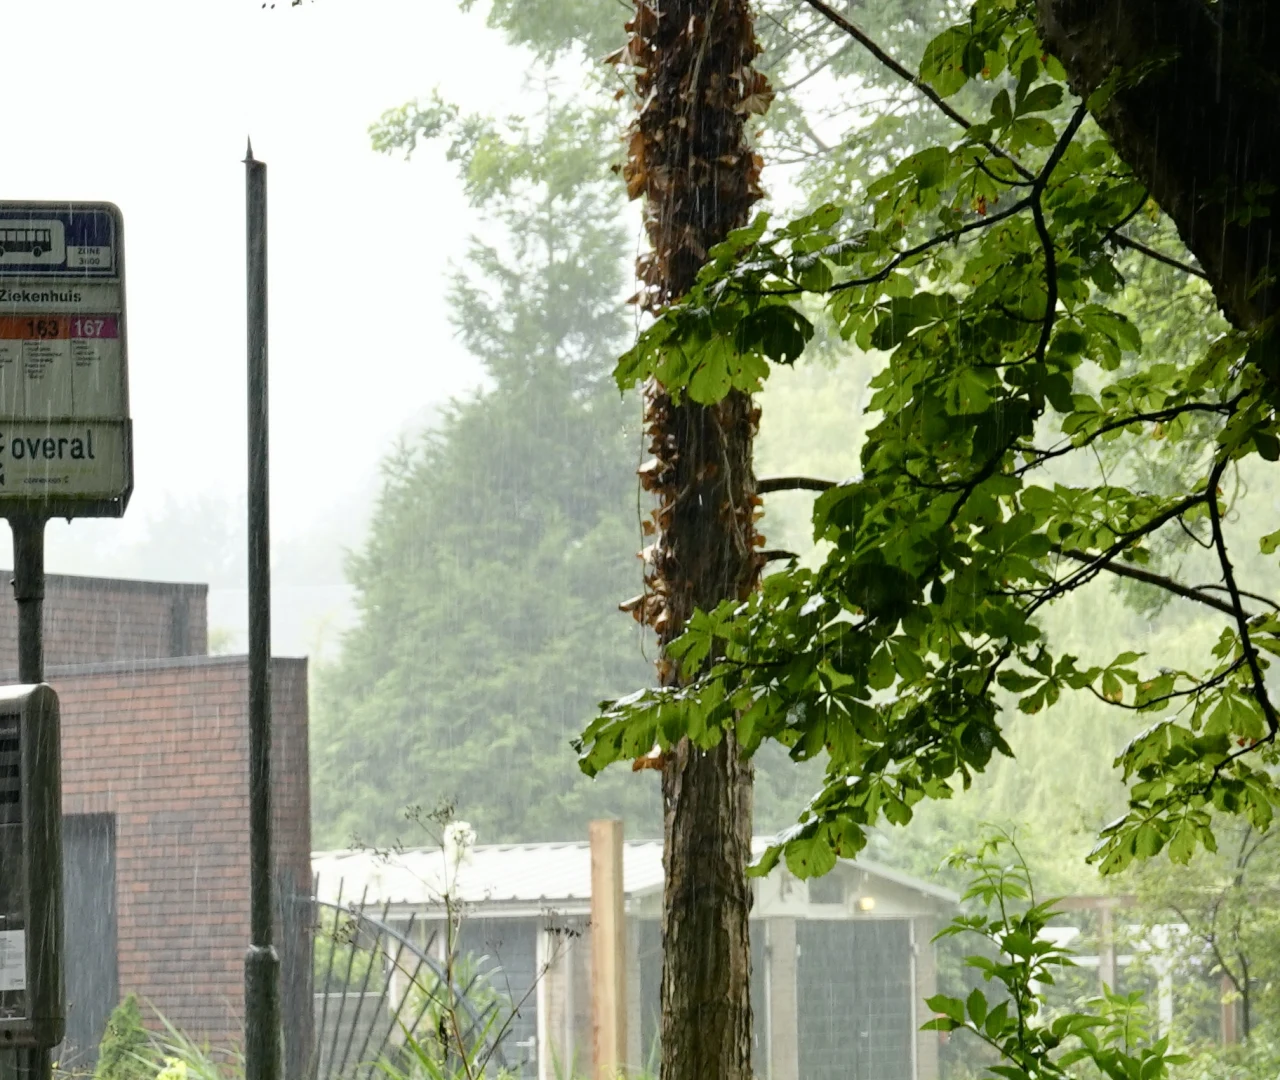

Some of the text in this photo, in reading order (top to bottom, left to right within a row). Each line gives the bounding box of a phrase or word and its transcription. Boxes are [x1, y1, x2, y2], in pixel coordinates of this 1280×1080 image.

[27, 320, 59, 337] 163
[74, 320, 104, 337] 167
[11, 429, 95, 460] overal
